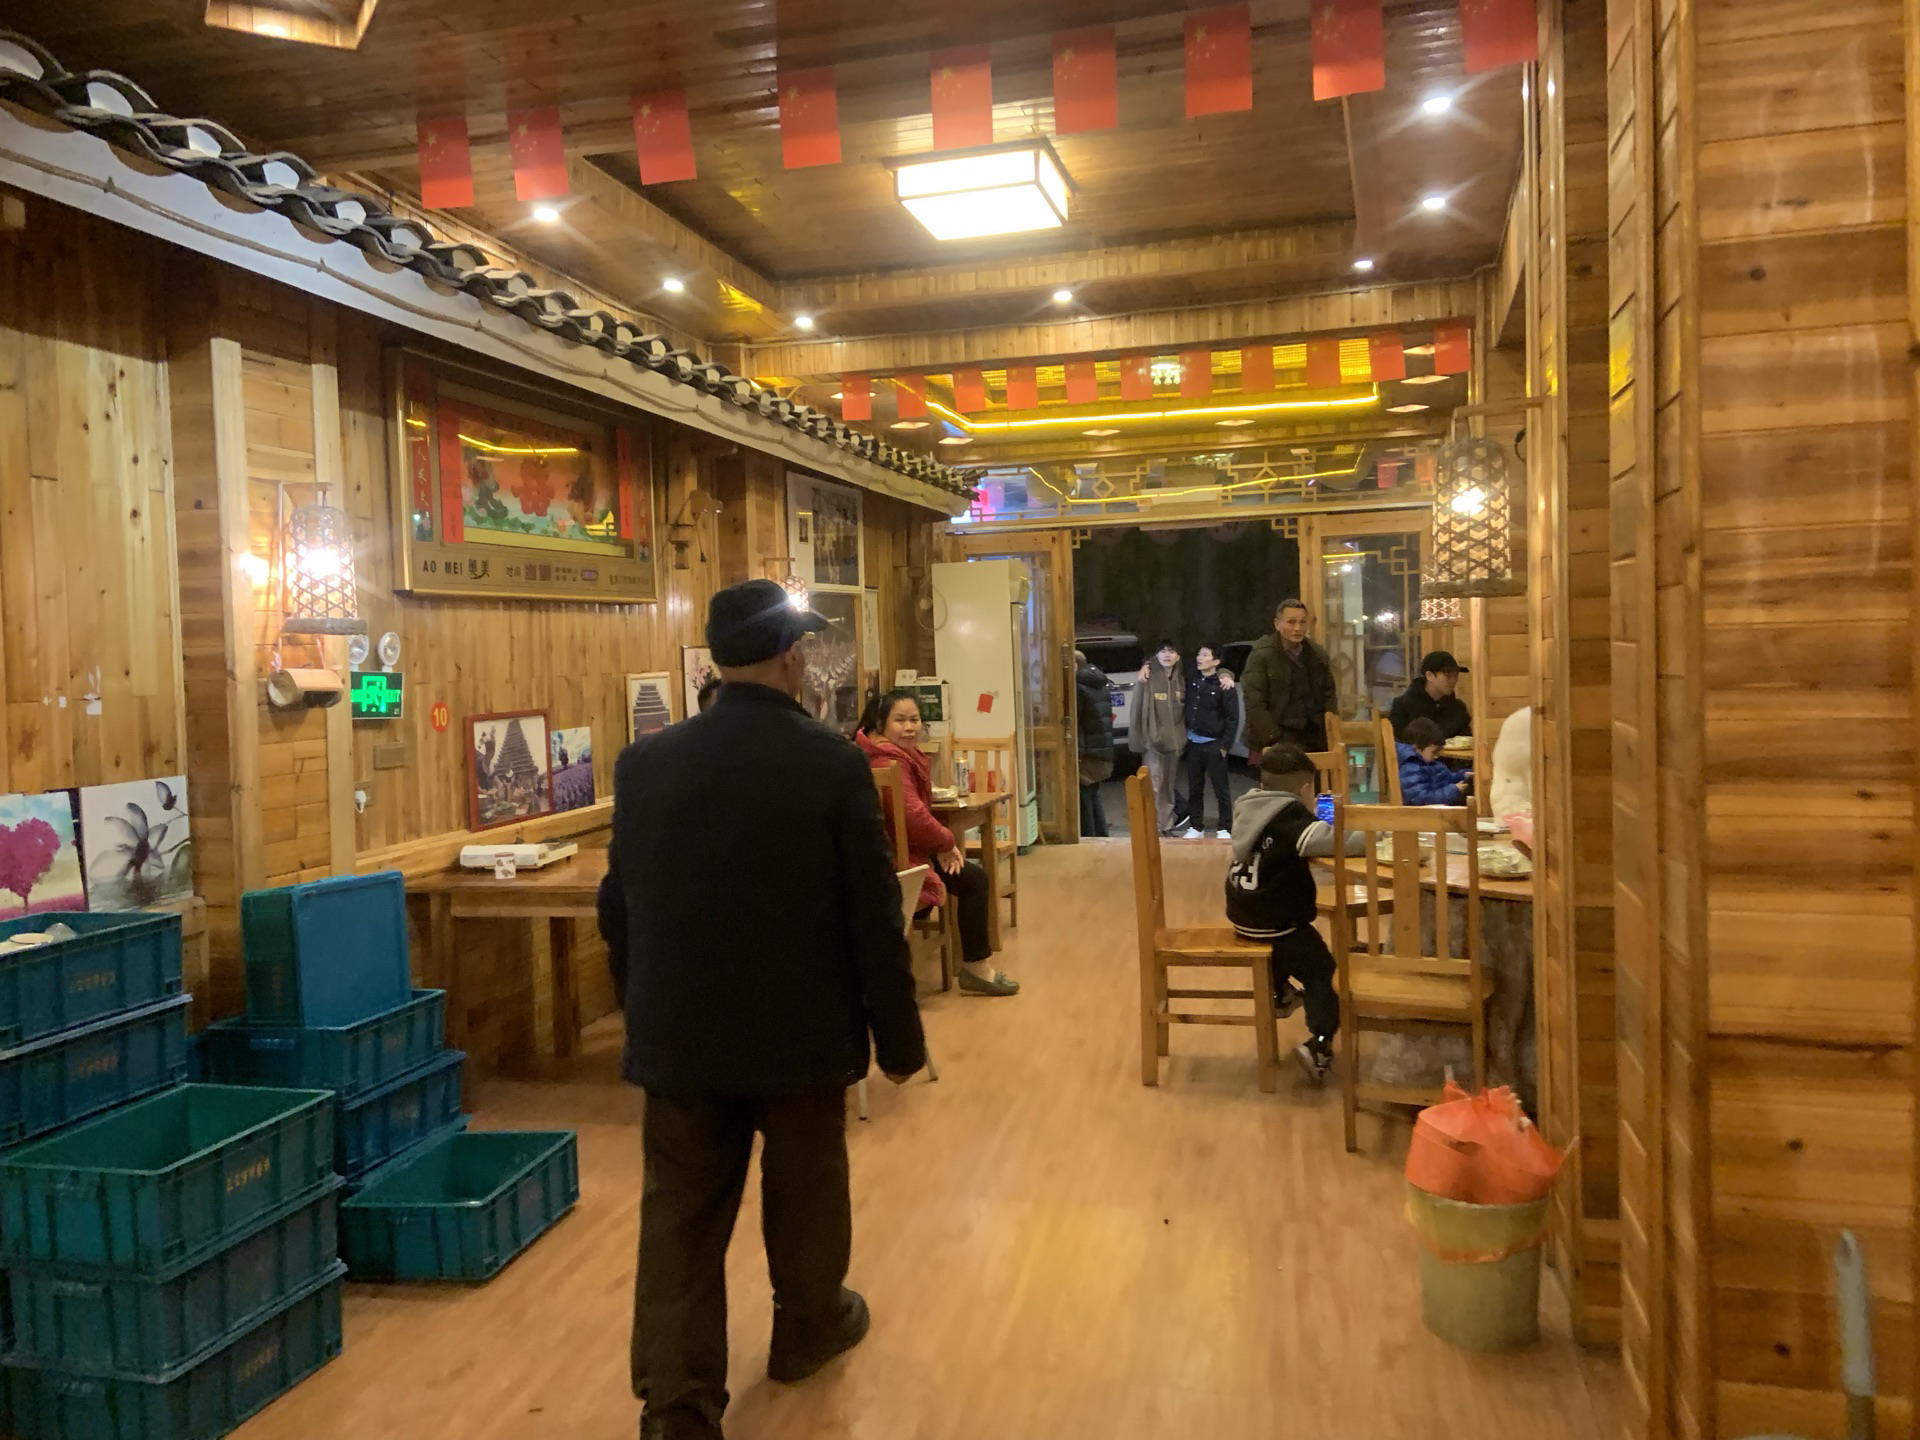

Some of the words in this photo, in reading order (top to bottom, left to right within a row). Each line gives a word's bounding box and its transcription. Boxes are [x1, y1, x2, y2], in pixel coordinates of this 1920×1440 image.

[423, 559, 437, 573] AO
[444, 561, 463, 576] MEI
[434, 707, 447, 727] 10
